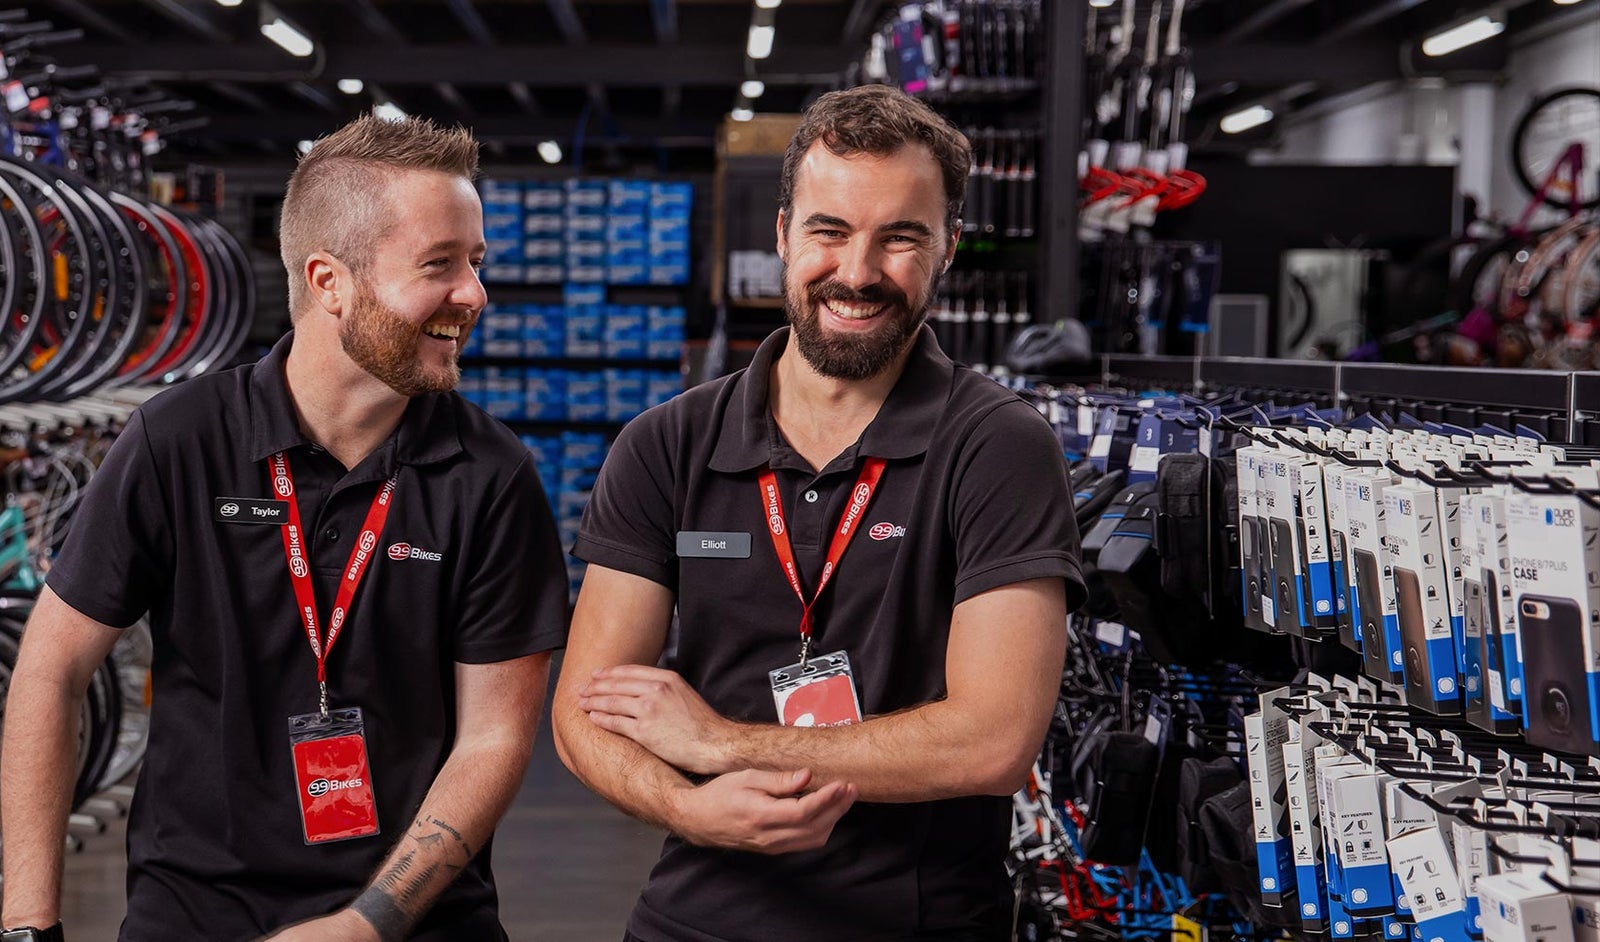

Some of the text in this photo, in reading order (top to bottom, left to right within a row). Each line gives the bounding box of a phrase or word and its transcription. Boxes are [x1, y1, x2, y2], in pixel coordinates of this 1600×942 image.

[251, 507, 280, 518] Taylor
[701, 539, 727, 550] Elliott
[1513, 567, 1539, 581] CASE
